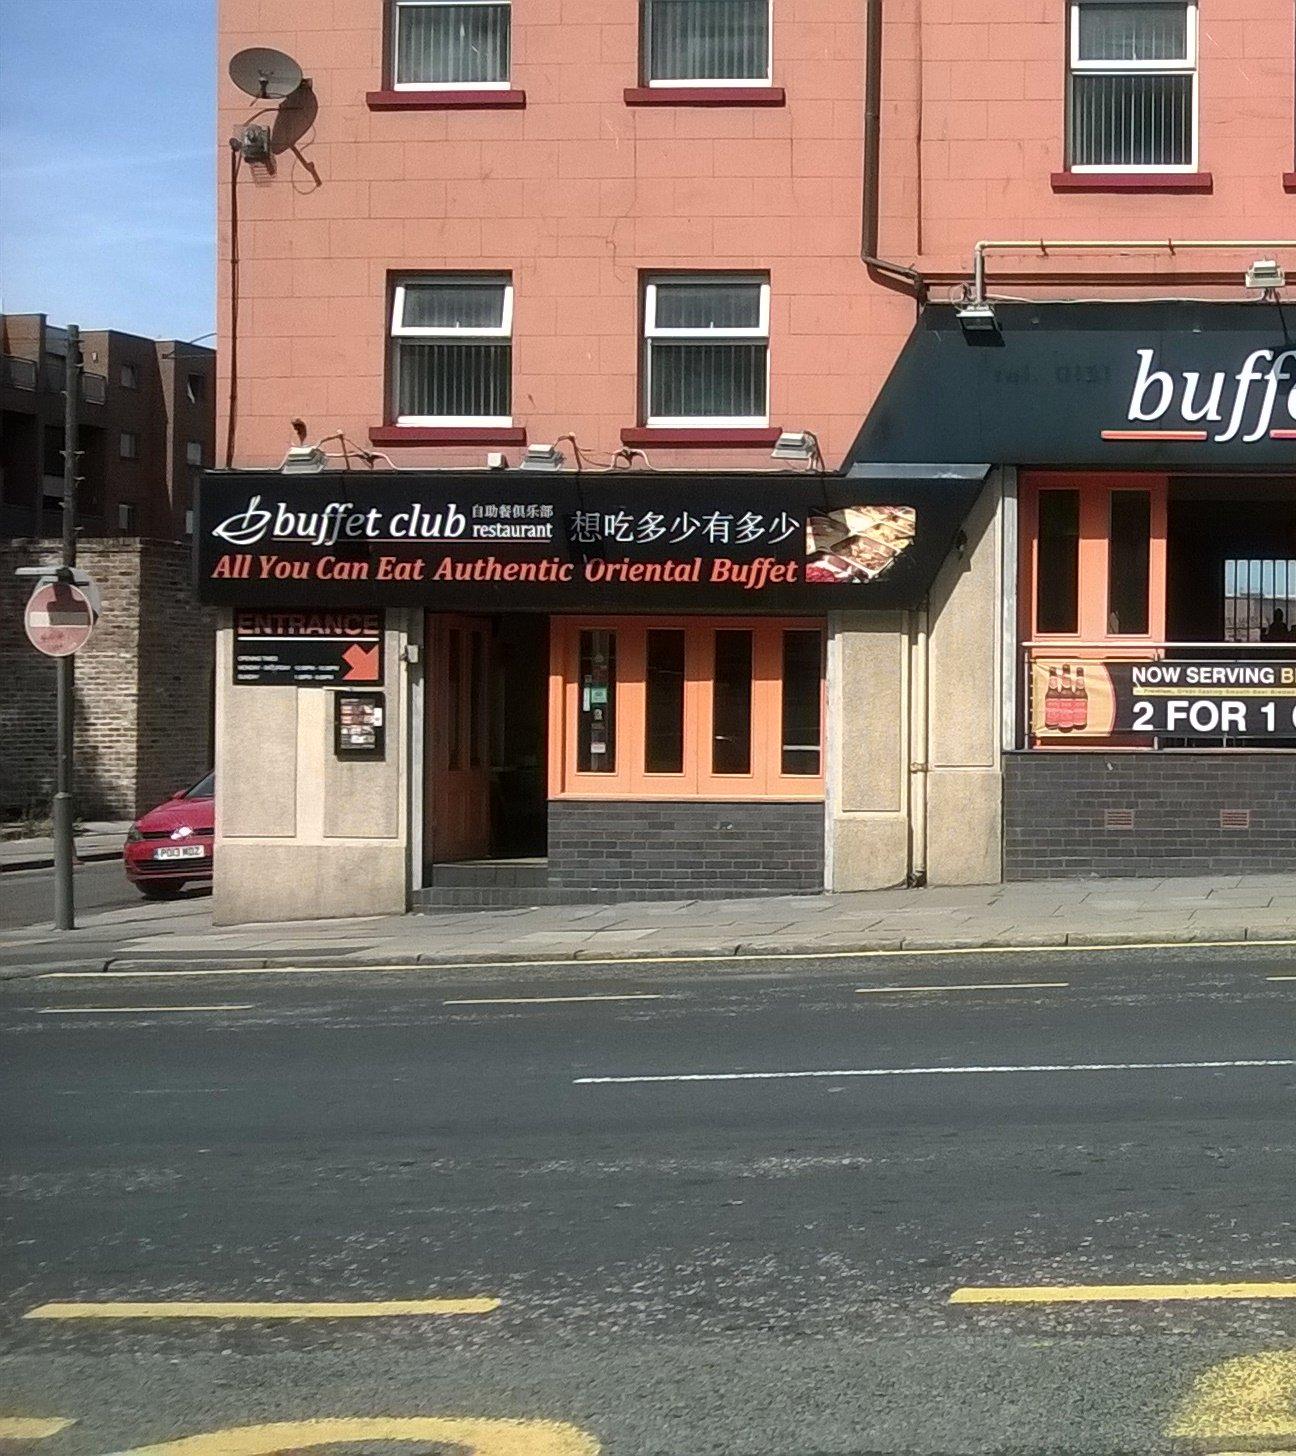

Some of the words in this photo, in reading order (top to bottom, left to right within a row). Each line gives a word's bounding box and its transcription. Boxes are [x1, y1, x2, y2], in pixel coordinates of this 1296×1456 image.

[272, 502, 381, 546] buffet
[389, 503, 466, 538] club
[472, 523, 554, 539] restaurant
[570, 510, 800, 544] 想吃多少有多少
[210, 554, 253, 579] All
[258, 555, 311, 580] You
[316, 556, 369, 580] Can
[375, 557, 426, 581] Eat
[433, 557, 574, 582] Authentic
[585, 557, 700, 583] Oriental
[710, 558, 798, 589] Buffet
[237, 614, 379, 635] ENTRANCE
[1132, 667, 1181, 683] NOW
[1186, 667, 1275, 684] SERVING
[1132, 701, 1154, 731] 2
[1167, 700, 1247, 732] FOR
[1260, 701, 1275, 732] 1
